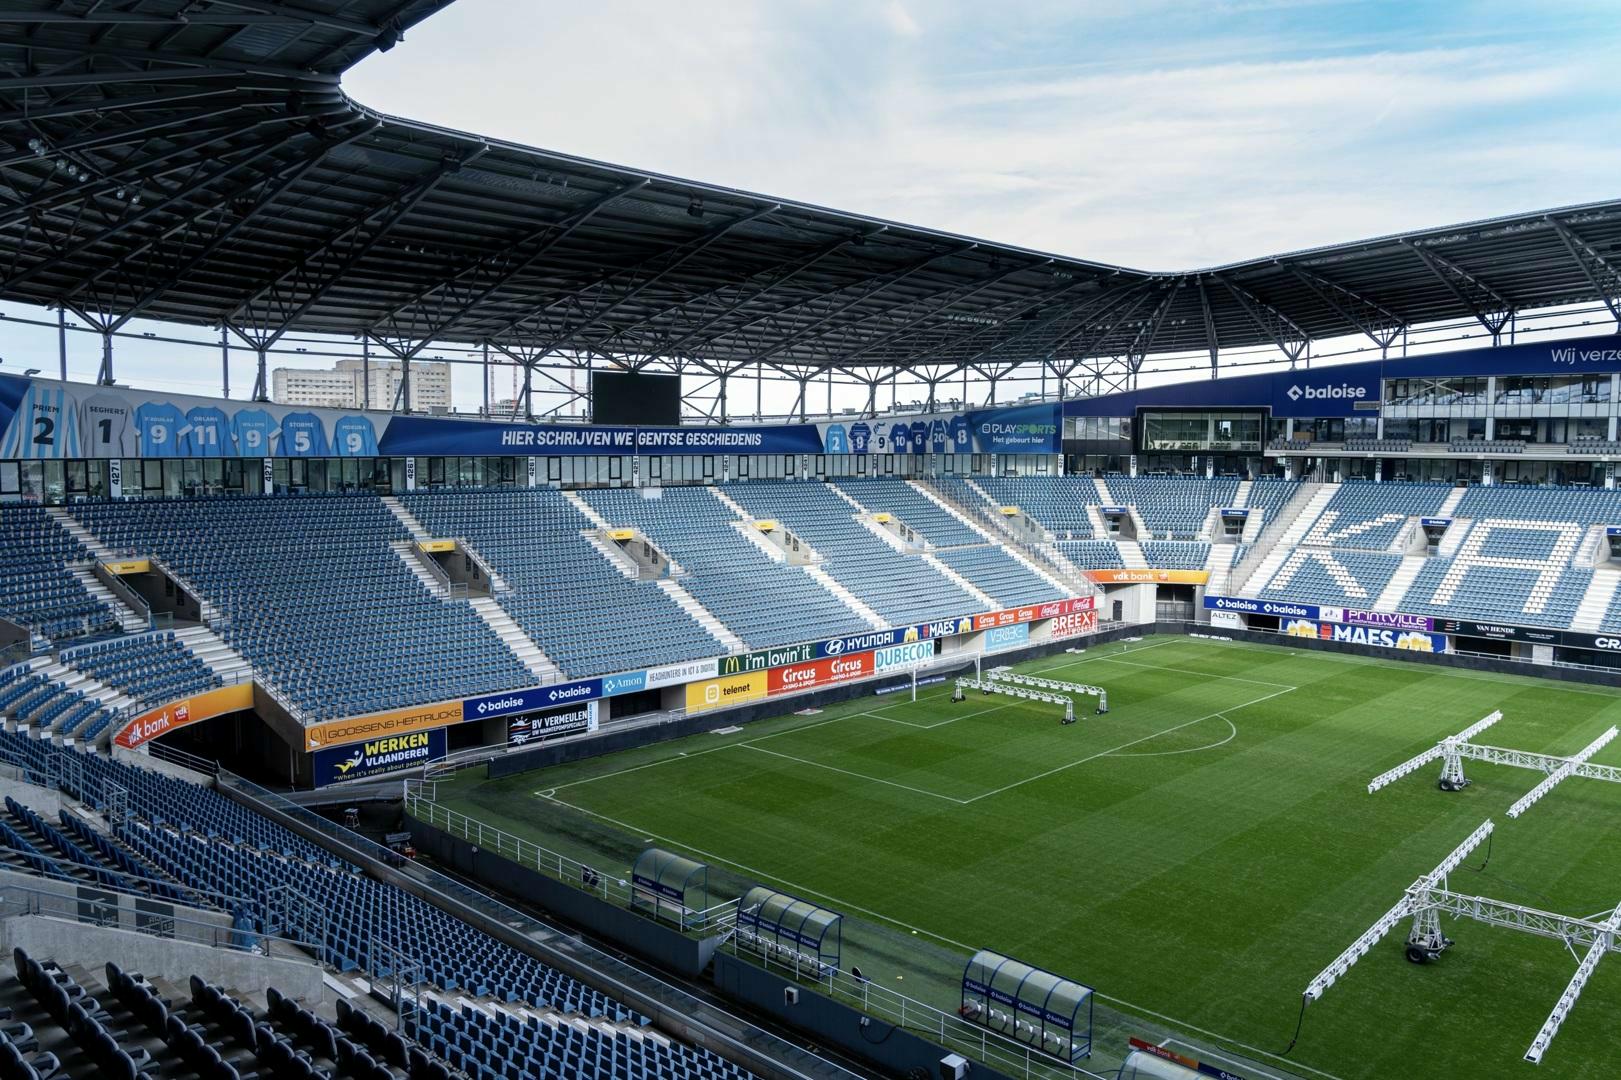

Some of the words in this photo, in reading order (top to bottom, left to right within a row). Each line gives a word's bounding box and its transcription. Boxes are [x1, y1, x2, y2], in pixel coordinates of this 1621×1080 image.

[1551, 347, 1576, 365] Wij
[1304, 383, 1367, 399] baloise
[32, 403, 60, 414] PRIEM
[89, 405, 125, 415] SEGHERS
[33, 417, 55, 445] 2
[99, 418, 112, 444] 1
[151, 425, 167, 444] 9
[194, 425, 217, 445] 11
[502, 431, 535, 446] HIER
[537, 431, 611, 446] SCHRIJVEN
[613, 432, 634, 446] WE
[638, 432, 684, 446] GENTSE
[686, 433, 762, 446] GESCHIEDENIS
[933, 433, 945, 443] 20
[957, 430, 967, 444] 8
[246, 430, 261, 448] 9
[295, 431, 310, 452] 5
[346, 433, 362, 453] 9
[832, 436, 840, 451] 2
[856, 436, 864, 449] 9
[878, 436, 886, 449] 9
[895, 436, 906, 447] 10
[915, 434, 922, 445] 6
[1005, 436, 1030, 444] gebeurt
[111, 466, 120, 486] 427
[264, 465, 273, 483] 427
[1113, 572, 1129, 580] vdk
[1130, 572, 1154, 580] bank
[1225, 599, 1258, 611] baloise
[1273, 604, 1307, 616] baloise
[1051, 611, 1091, 631] BREEX
[1212, 612, 1237, 620] ALTEZ
[929, 620, 955, 637] MAES
[1491, 625, 1516, 634] HENDE
[847, 632, 894, 651] HYUNDAI
[1334, 625, 1394, 648] MAES
[745, 654, 765, 671] i'm
[768, 647, 800, 666] lovin'
[802, 645, 811, 660] it
[875, 642, 933, 668] DUBECOR
[831, 659, 862, 673] Circus
[615, 677, 642, 688] Amon
[782, 667, 816, 683] Circus
[558, 685, 592, 699] baloise
[723, 683, 750, 696] telenet
[488, 697, 524, 711] baloise
[144, 711, 170, 737] bank
[328, 720, 395, 738] GOOSSENS
[396, 709, 462, 726] HEFTRUCKS
[532, 718, 543, 730] BV
[544, 710, 588, 727] VERMEULEN
[364, 733, 429, 756] WERKEN
[366, 747, 429, 767] VLAANDEREN
[368, 766, 386, 775] really
[387, 763, 404, 771] about
[1022, 1004, 1041, 1015] baloise
[1051, 1015, 1069, 1027] baloise
